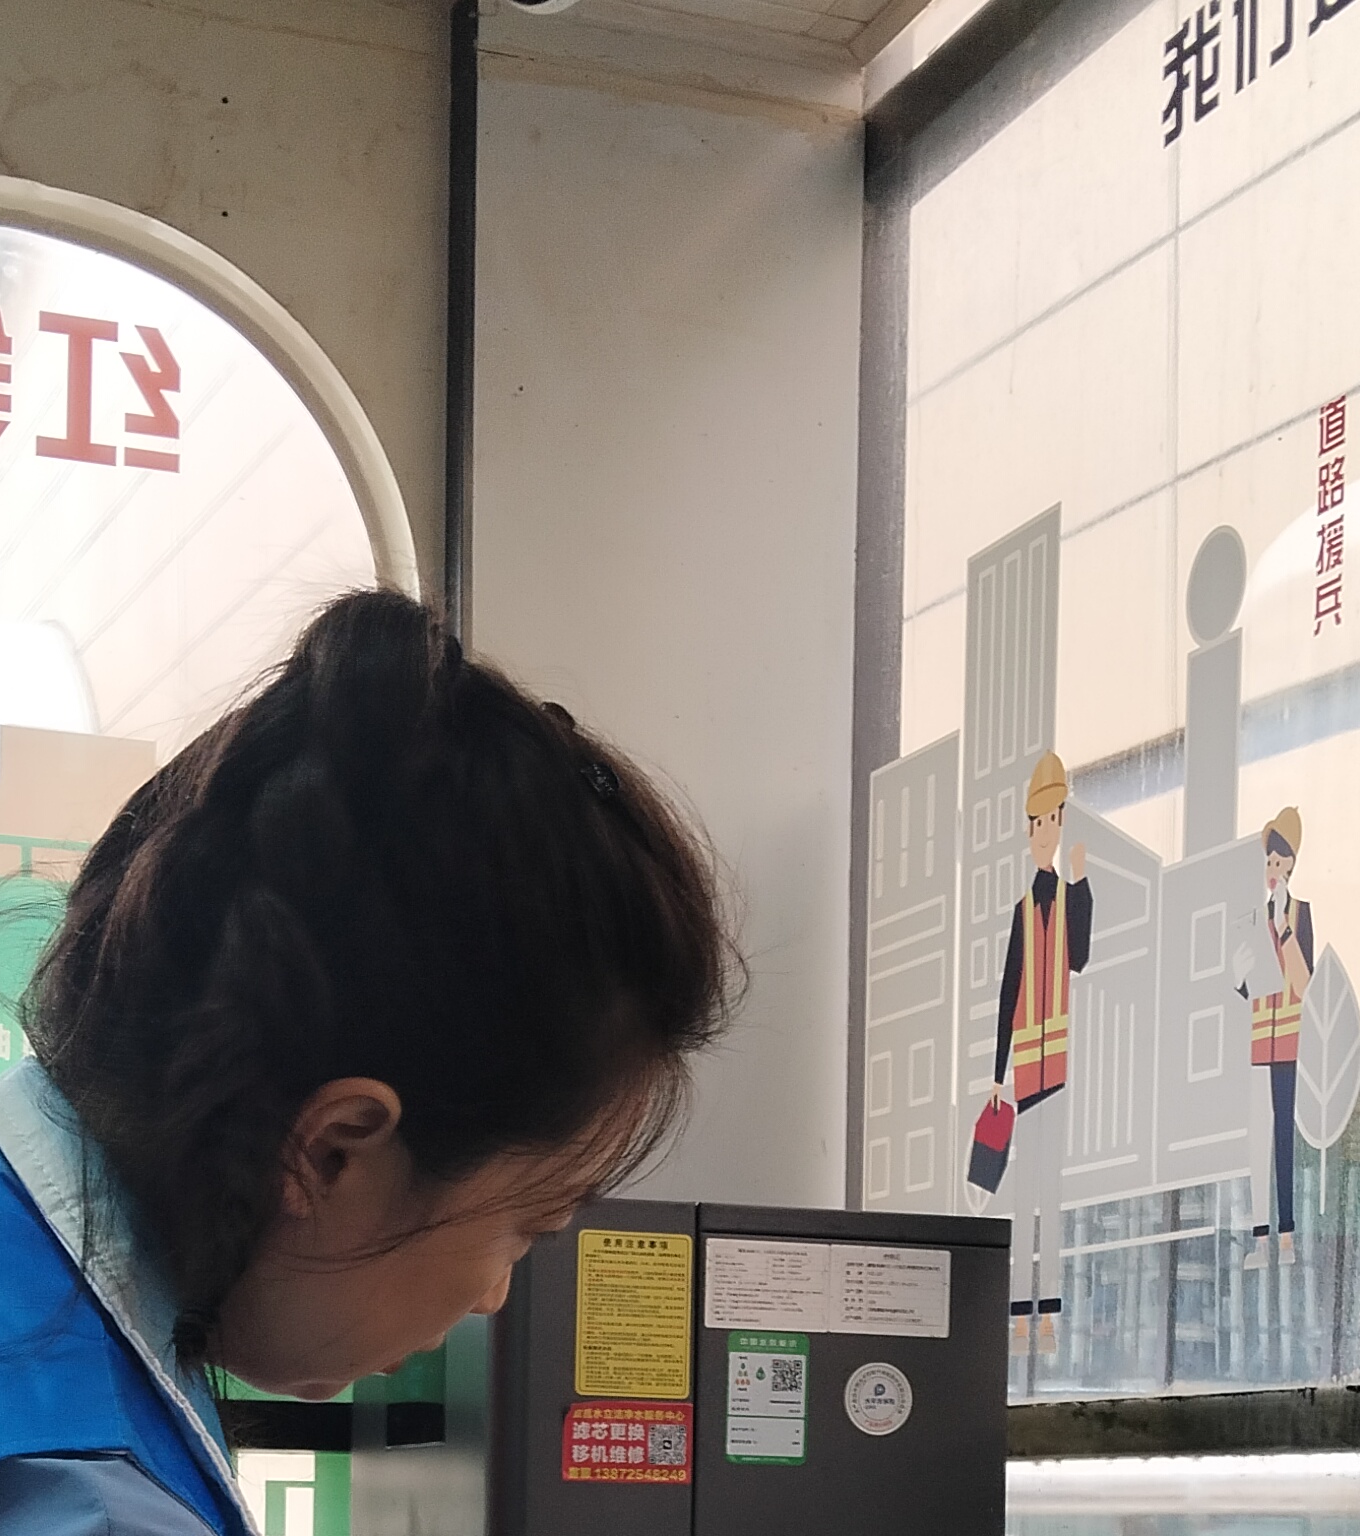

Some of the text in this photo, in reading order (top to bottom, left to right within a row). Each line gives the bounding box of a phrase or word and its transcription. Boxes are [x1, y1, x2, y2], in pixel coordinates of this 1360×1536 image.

[1161, 0, 1348, 148] 我们
[1314, 394, 1347, 637] 道路援兵
[571, 1445, 645, 1464] 移机维修
[572, 1421, 646, 1441] 滤芯更换
